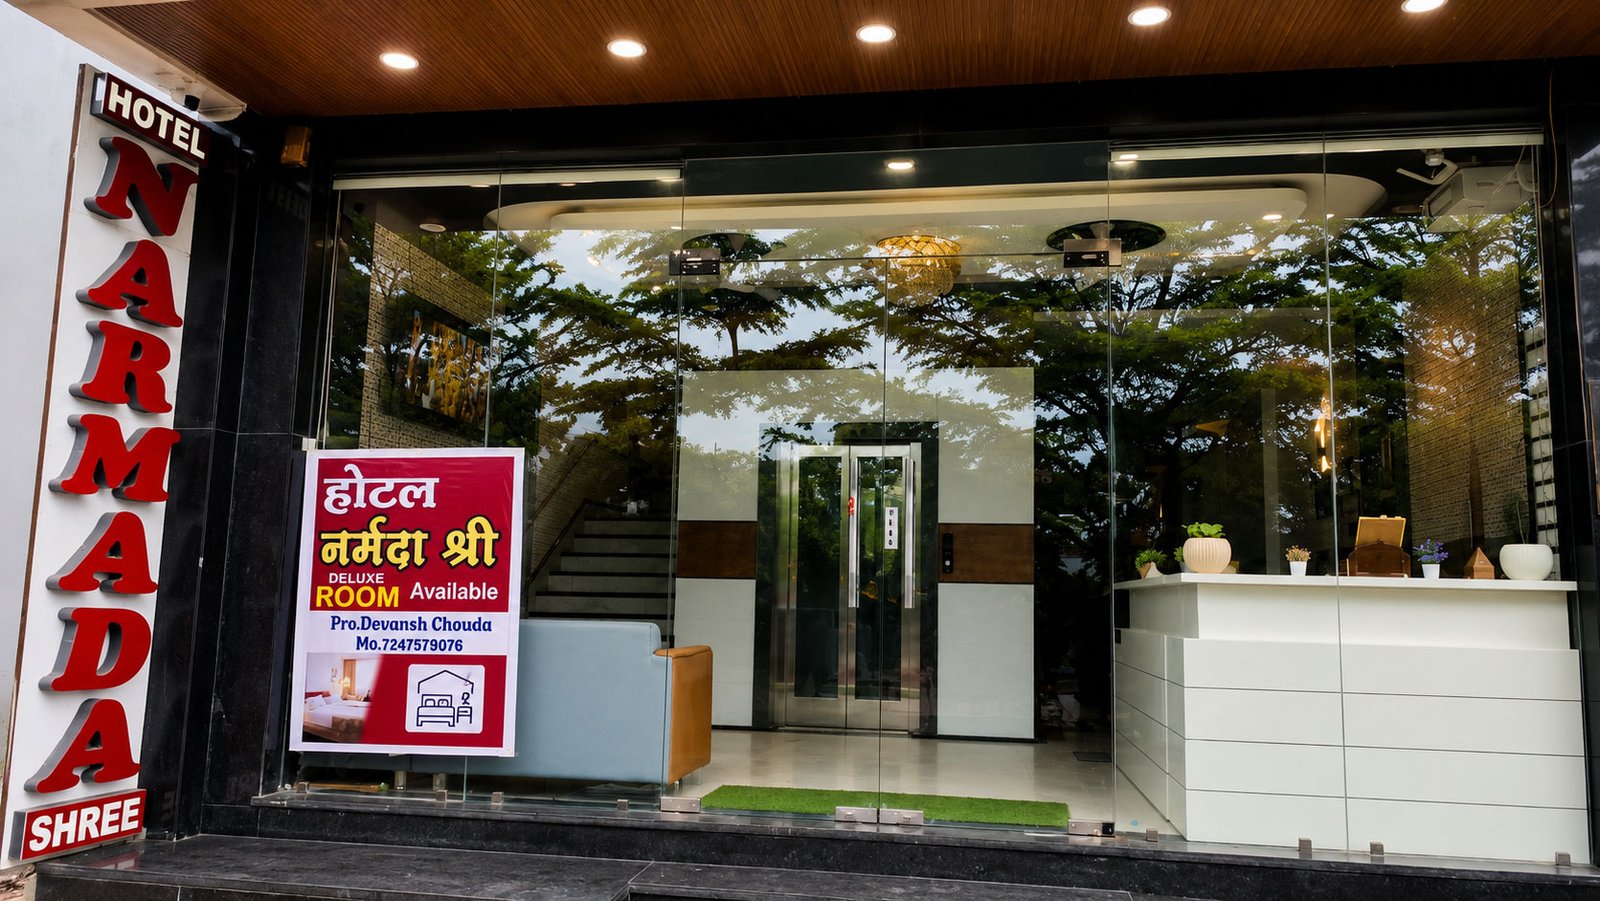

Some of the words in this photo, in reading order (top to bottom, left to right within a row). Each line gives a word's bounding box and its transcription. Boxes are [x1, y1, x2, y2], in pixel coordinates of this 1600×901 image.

[108, 81, 205, 160] HOTEL
[26, 136, 200, 794] NARMADA
[323, 463, 440, 515] होटल
[319, 515, 428, 570] नर्मदा
[441, 515, 500, 570] श्री
[315, 585, 400, 608] ROOM
[409, 582, 499, 600] Available
[328, 572, 385, 584] DELUXE
[330, 615, 428, 632] Pro.Devansh
[431, 616, 492, 632] Chouda
[356, 636, 463, 652] Mo.7247579076
[28, 797, 142, 853] SHREE
